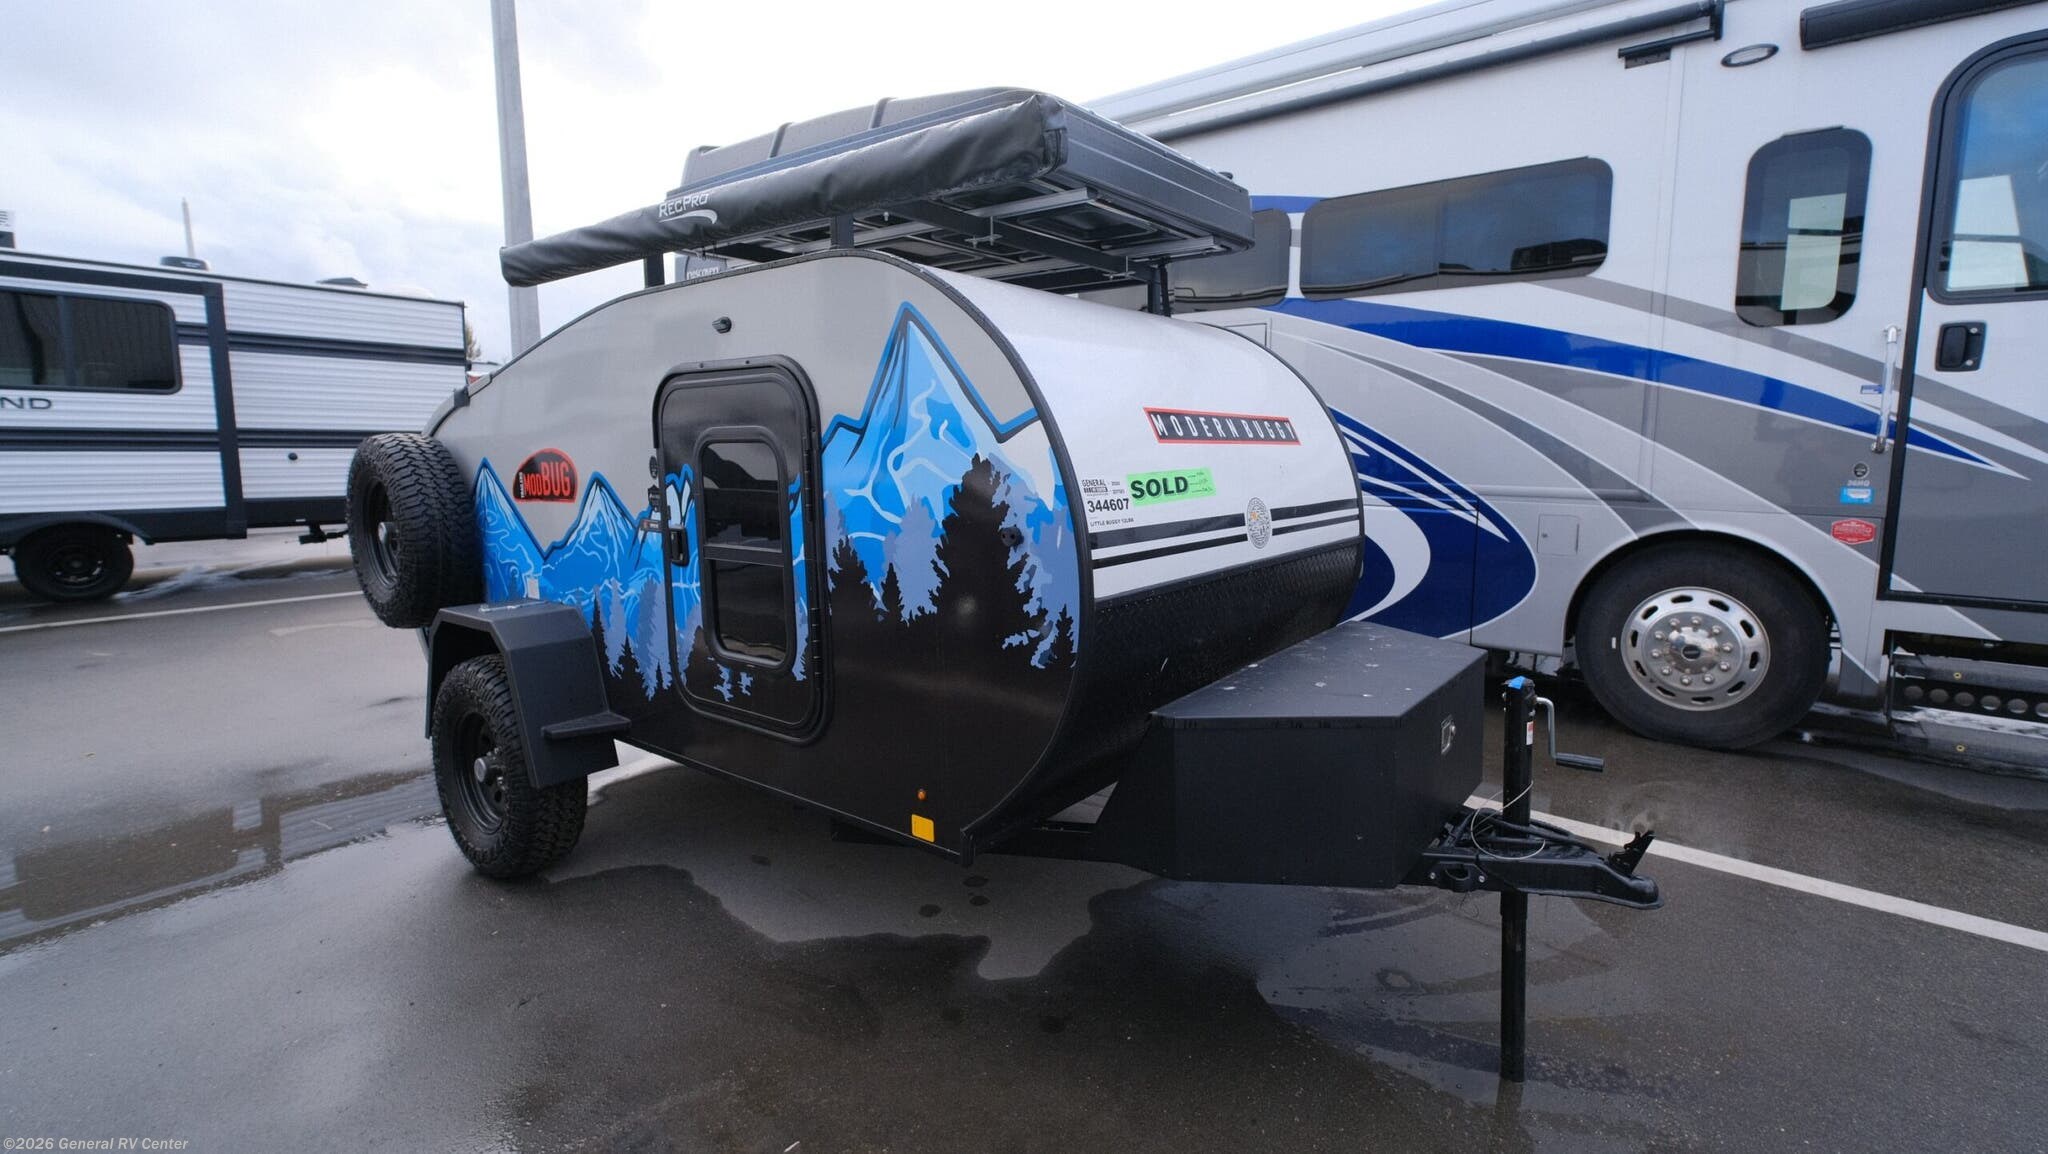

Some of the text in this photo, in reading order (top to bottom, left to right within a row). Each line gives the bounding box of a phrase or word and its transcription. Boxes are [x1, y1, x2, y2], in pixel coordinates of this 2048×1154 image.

[1151, 413, 1296, 440] MODERN BUGGY
[1082, 479, 1106, 488] GENERAL
[1130, 476, 1189, 499] SOLD
[1087, 498, 1130, 513] 344607
